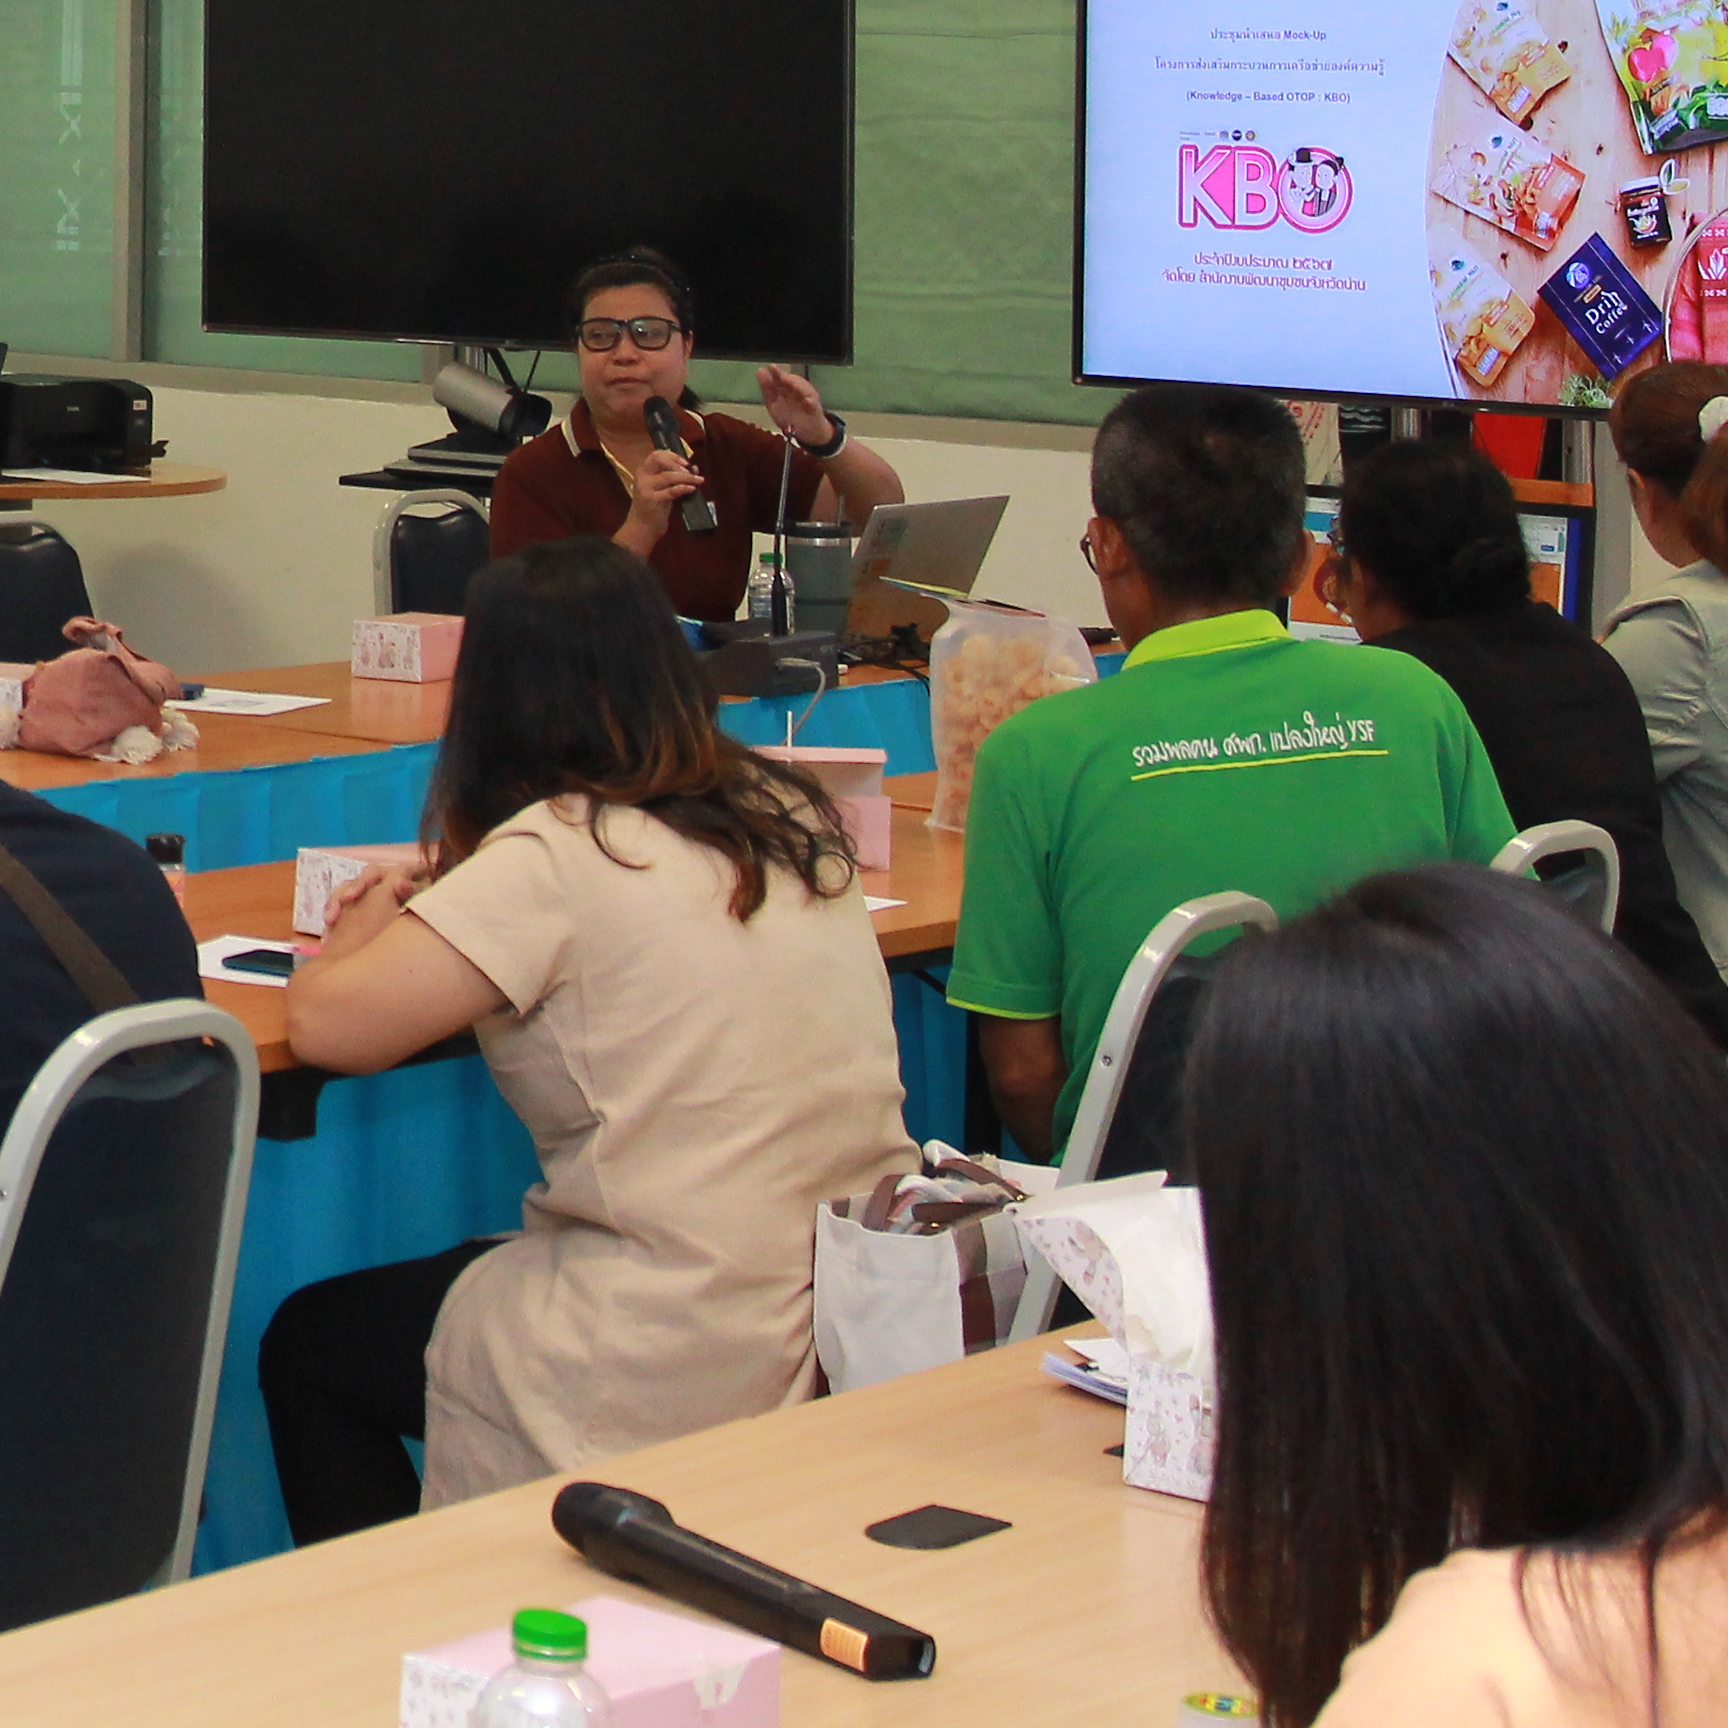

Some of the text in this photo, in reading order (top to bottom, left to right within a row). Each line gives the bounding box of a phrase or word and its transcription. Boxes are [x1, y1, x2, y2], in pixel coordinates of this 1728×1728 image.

[1209, 28, 1327, 44] ประชุมนำเสนอ Mock-Up
[1186, 90, 1243, 103] (Knowledge
[1253, 91, 1284, 102] Based
[1286, 91, 1316, 102] OTOP
[1324, 92, 1351, 104] KBO)
[1177, 143, 1355, 234] KBO
[1193, 251, 1333, 271] ประจำปีงบประมาณ ๒๕๖๗
[1162, 266, 1367, 292] จัดโดย สำนักงานพัฒนาชุมชนจังหวัดน่าน
[1595, 301, 1629, 335] Coffee
[1132, 737, 1219, 768] รวมพลคน
[1270, 710, 1348, 750] แปลงใหญ่
[1347, 719, 1375, 743] YSF
